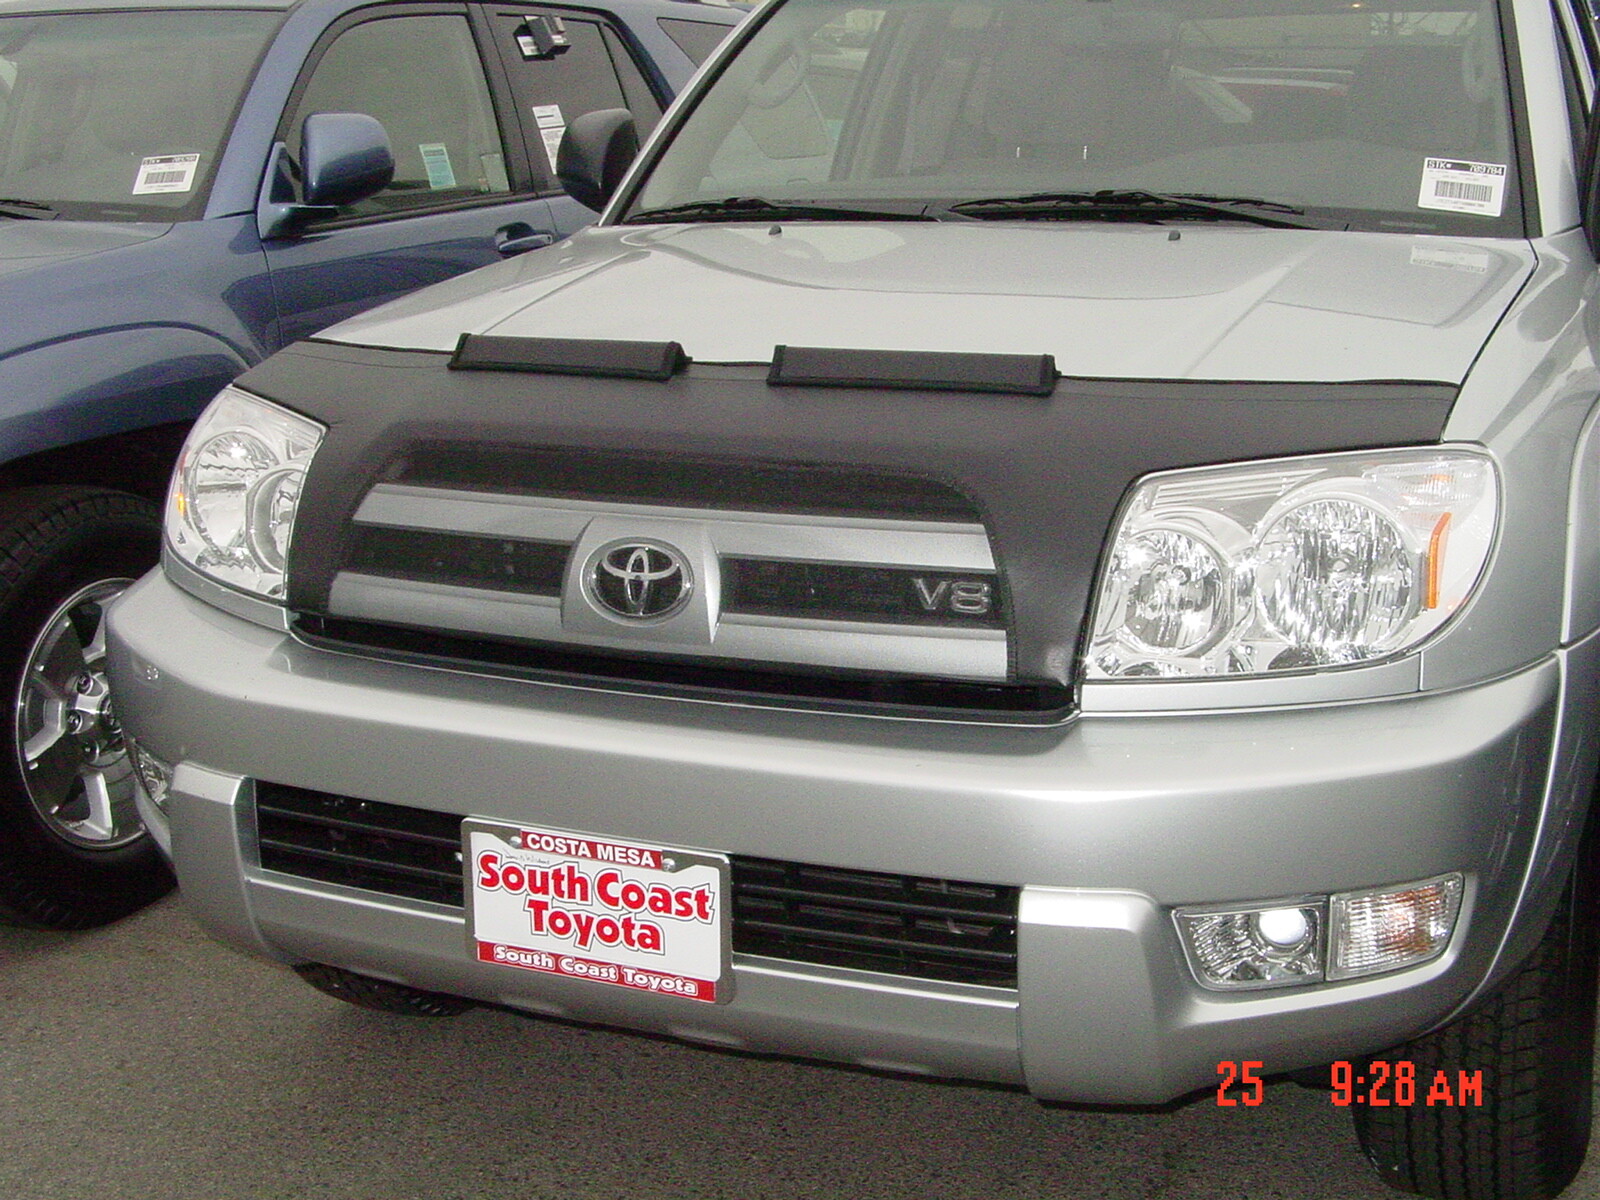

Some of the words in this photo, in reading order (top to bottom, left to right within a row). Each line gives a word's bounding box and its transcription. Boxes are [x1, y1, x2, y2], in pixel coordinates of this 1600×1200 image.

[913, 578, 992, 614] V8
[526, 833, 592, 858] COSTA
[596, 844, 655, 868] MESA
[480, 854, 589, 902] South
[598, 871, 711, 921] Coast
[526, 898, 662, 951] Toyota
[494, 946, 555, 969] South
[560, 957, 618, 980] Coast
[623, 967, 698, 996] Toyota
